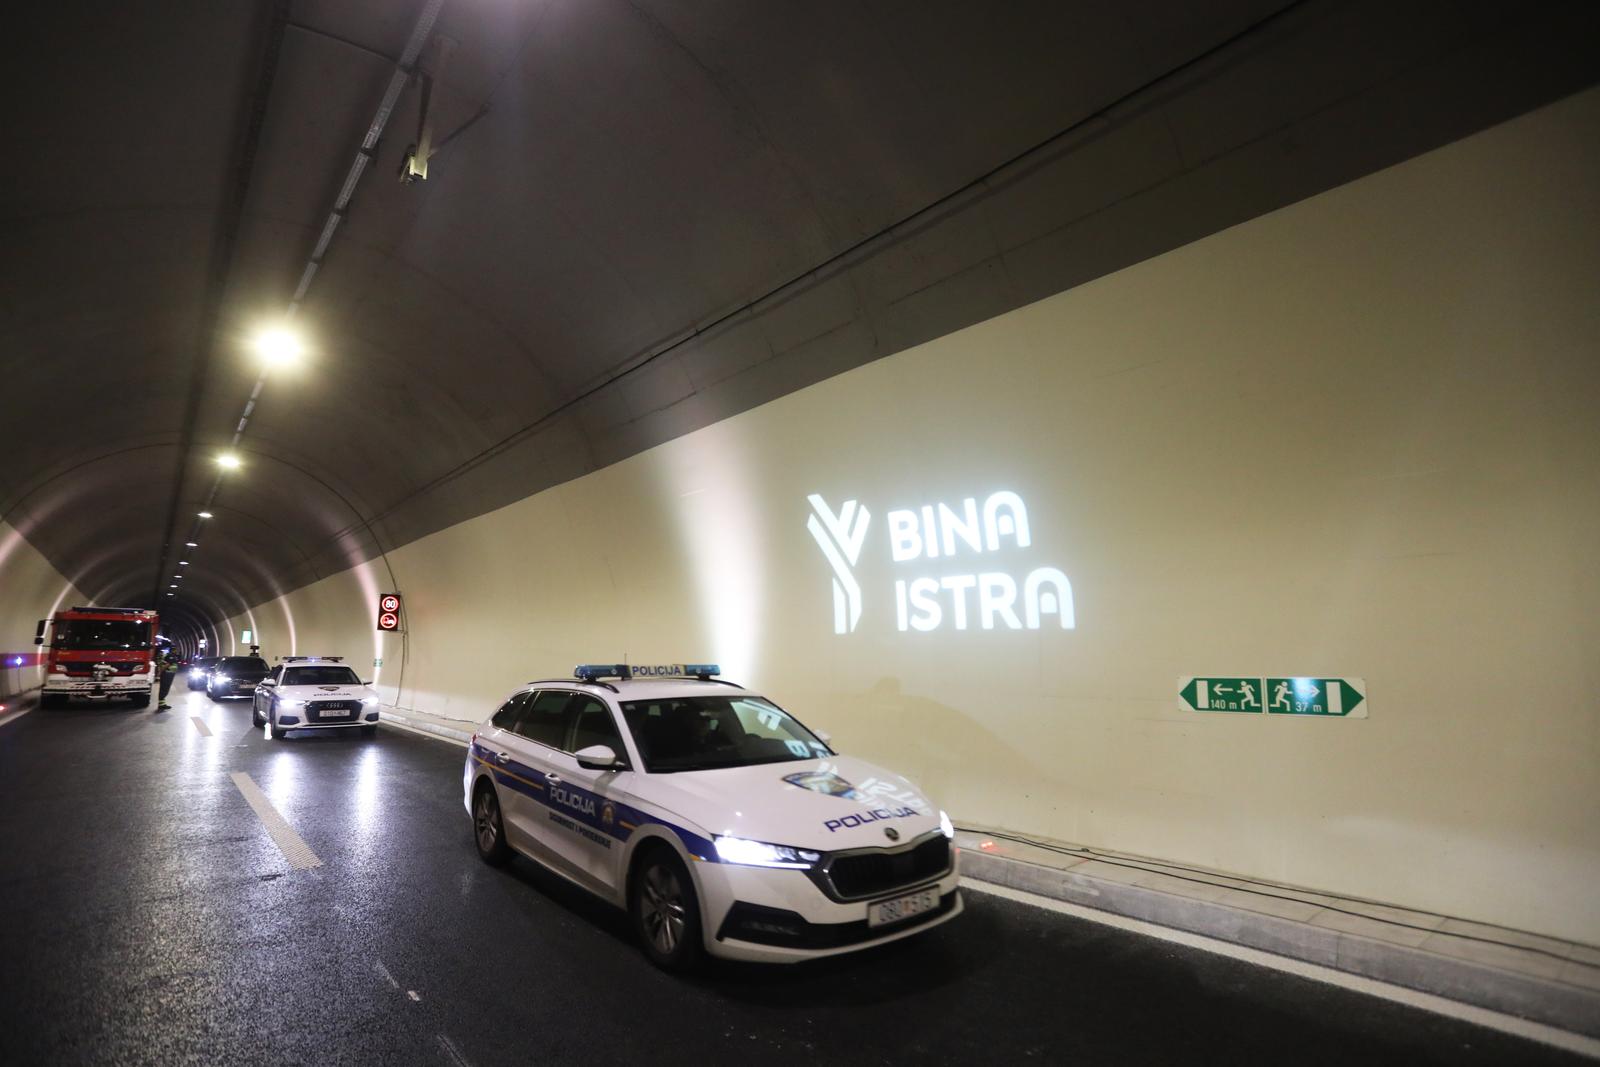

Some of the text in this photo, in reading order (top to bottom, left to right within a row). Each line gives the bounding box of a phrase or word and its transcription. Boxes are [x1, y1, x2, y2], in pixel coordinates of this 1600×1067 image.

[887, 490, 1031, 562] BINA
[385, 599, 396, 609] 80
[895, 567, 1075, 632] ISTRA
[632, 665, 681, 676] POLICIJA
[1210, 699, 1237, 710] 140 m
[1295, 701, 1322, 713] 37 m
[550, 787, 596, 817] POLICIJA
